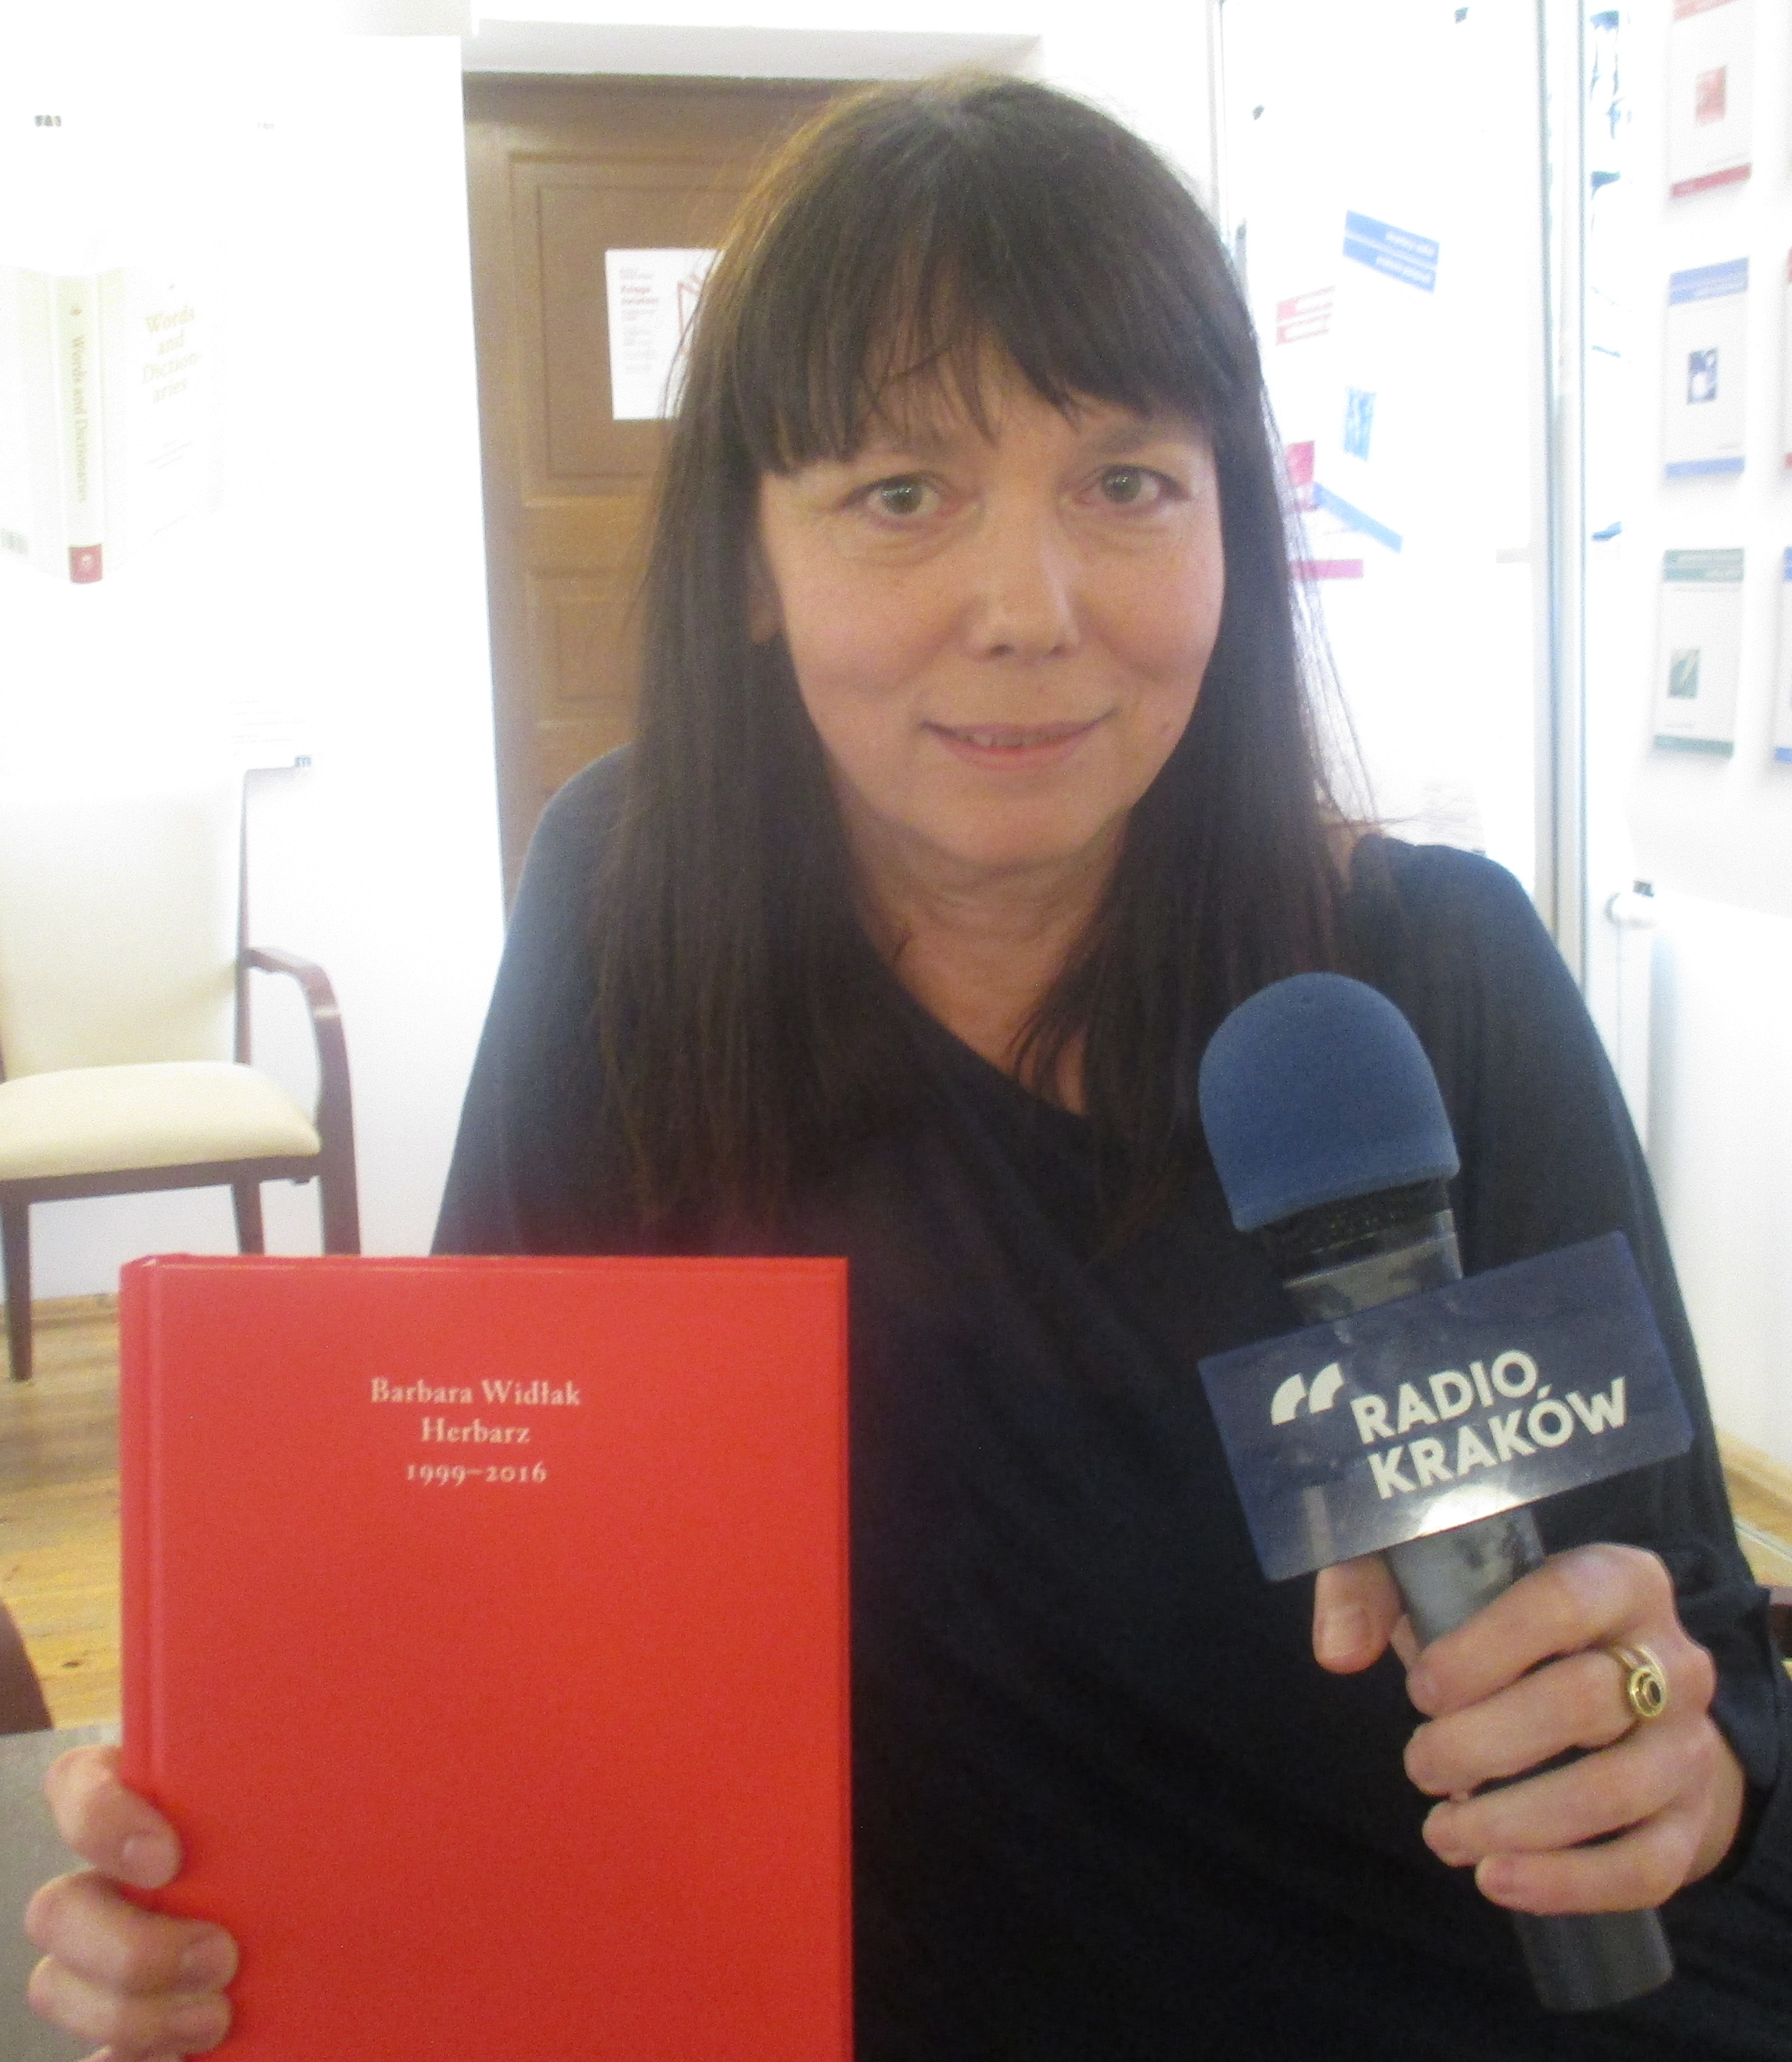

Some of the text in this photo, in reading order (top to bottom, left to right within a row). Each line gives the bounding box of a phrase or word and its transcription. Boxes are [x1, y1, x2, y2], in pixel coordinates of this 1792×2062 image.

[145, 302, 193, 333] Words
[156, 327, 185, 355] and
[71, 334, 87, 383] Words
[72, 387, 88, 415] and
[371, 1376, 474, 1404] Barbara
[1349, 1349, 1538, 1444] RADIO
[421, 1416, 531, 1443] Herbarz
[1367, 1376, 1626, 1500] KRAKÓW
